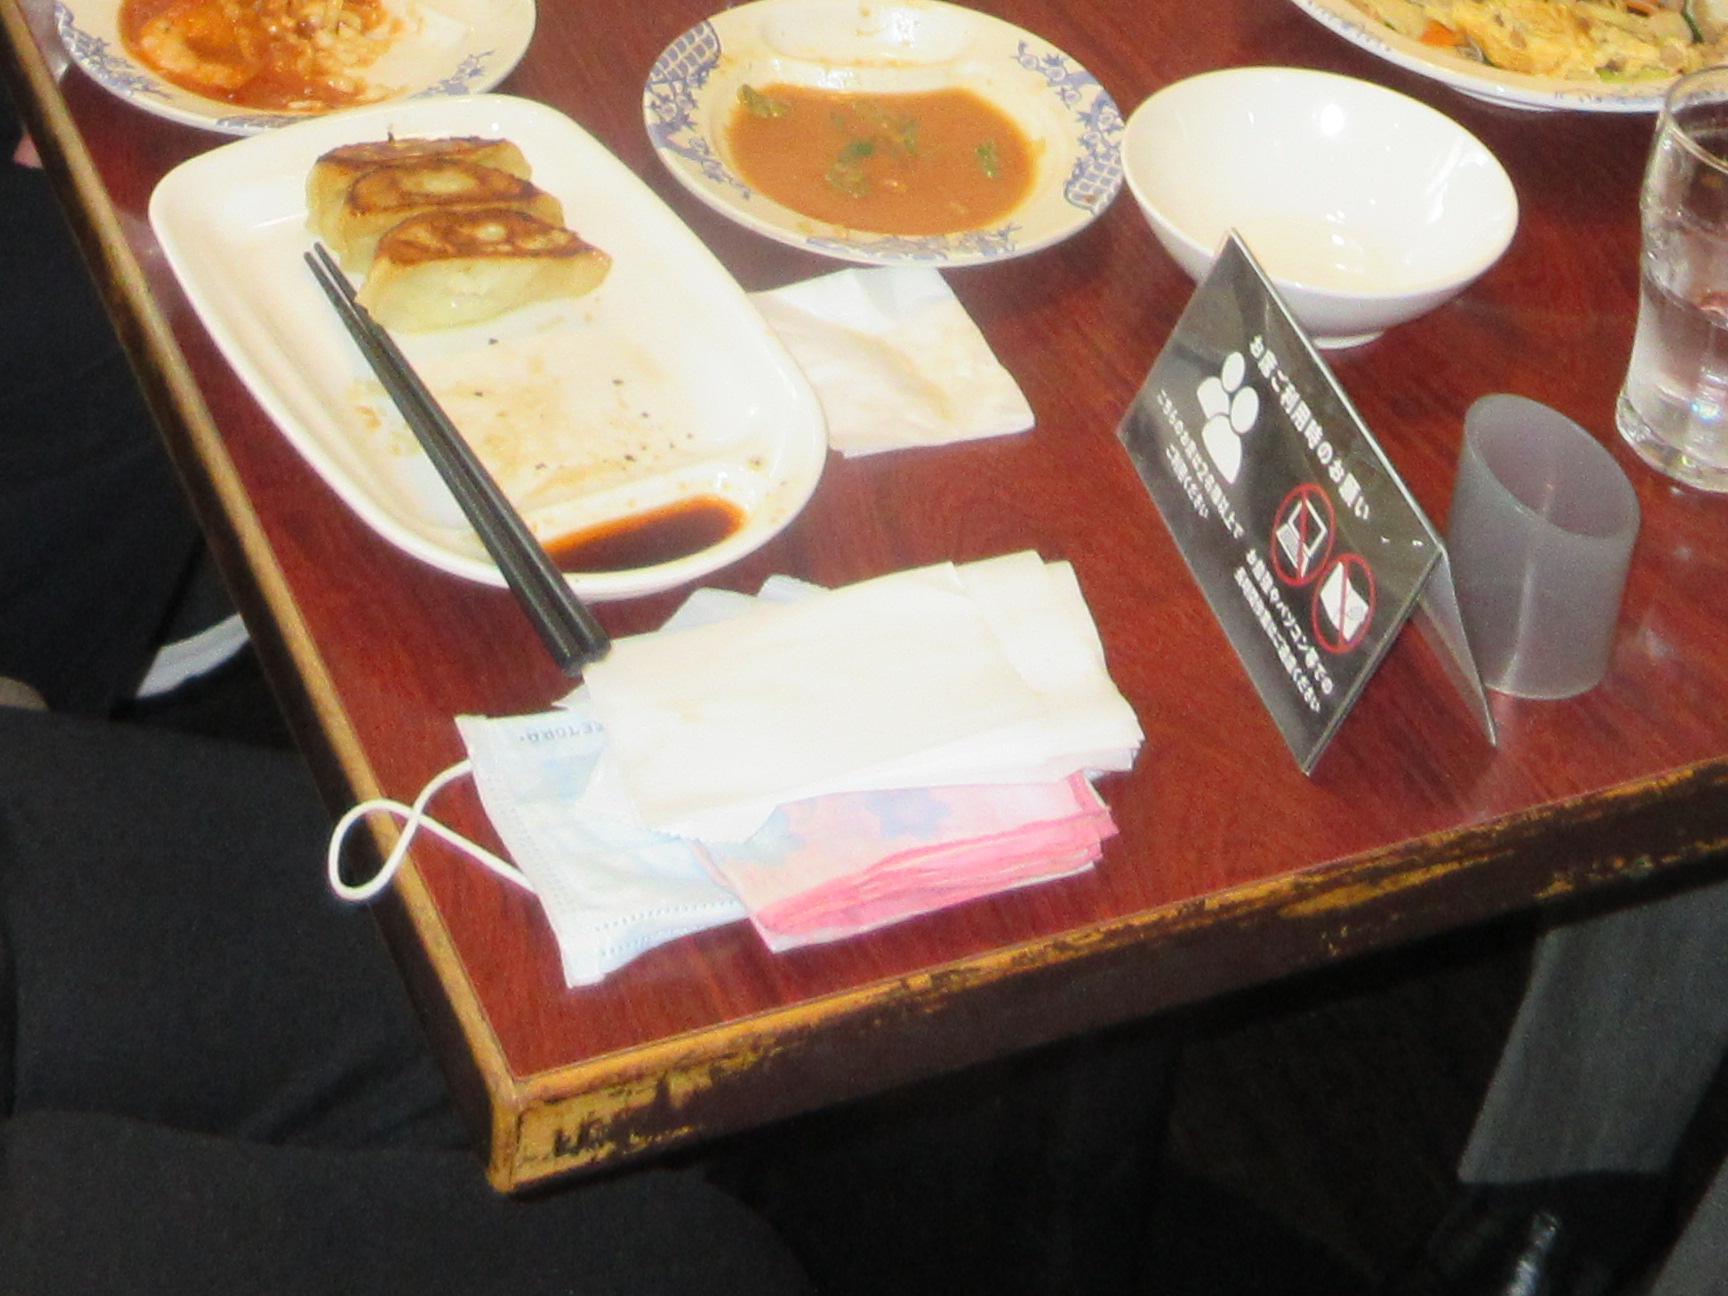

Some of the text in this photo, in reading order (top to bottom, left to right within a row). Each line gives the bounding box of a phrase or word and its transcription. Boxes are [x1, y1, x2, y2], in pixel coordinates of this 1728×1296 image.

[1249, 334, 1370, 520] お席ご利用時のお願い
